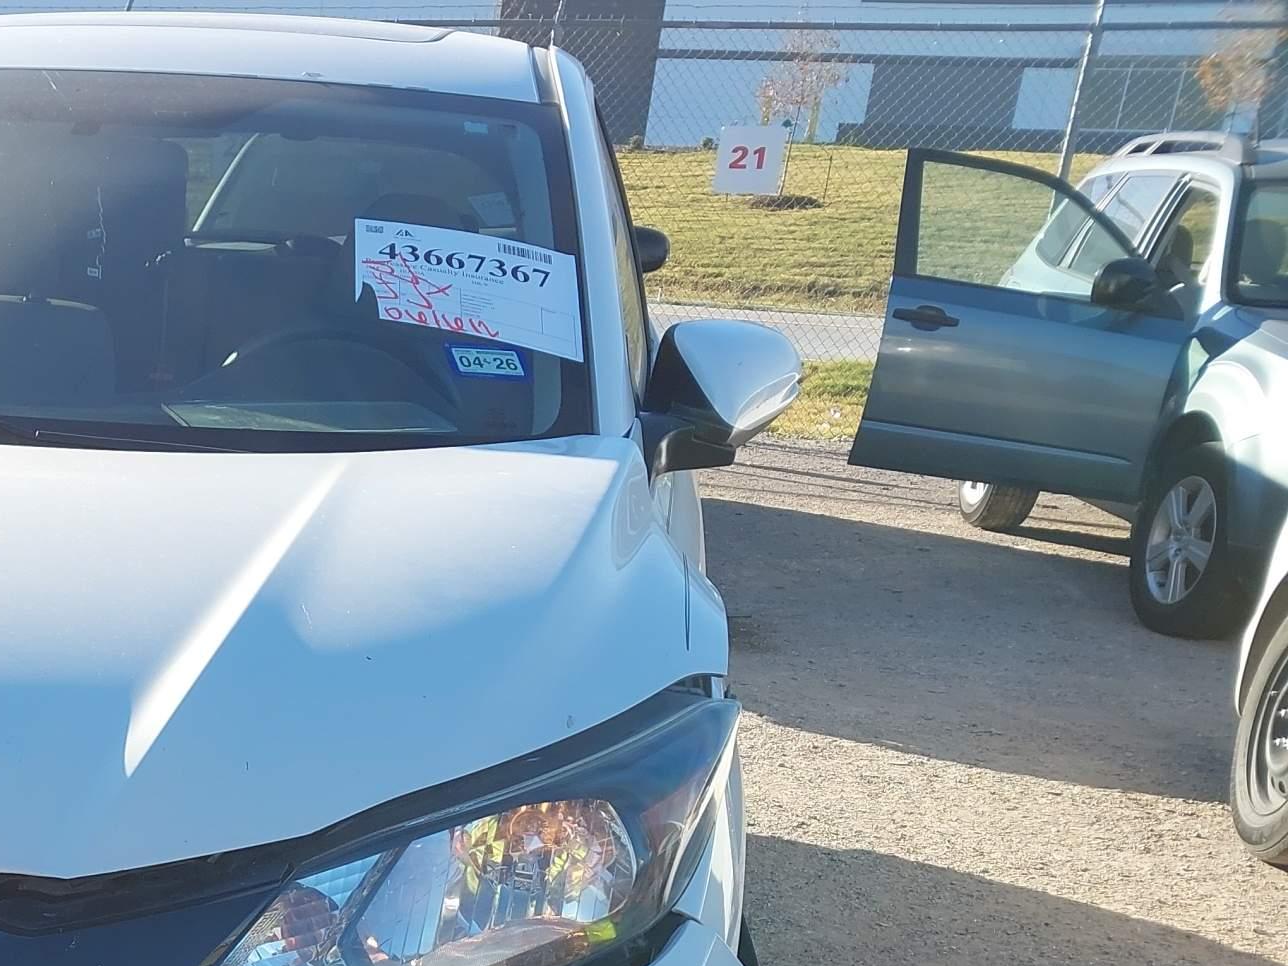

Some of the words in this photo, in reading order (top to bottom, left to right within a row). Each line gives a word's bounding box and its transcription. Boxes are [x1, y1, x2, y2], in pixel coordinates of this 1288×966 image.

[728, 145, 767, 170] 21
[378, 243, 551, 288] 43667367
[420, 264, 458, 278] Casualty
[462, 271, 505, 286] Insurance
[458, 355, 485, 369] 04
[493, 357, 518, 371] 26
